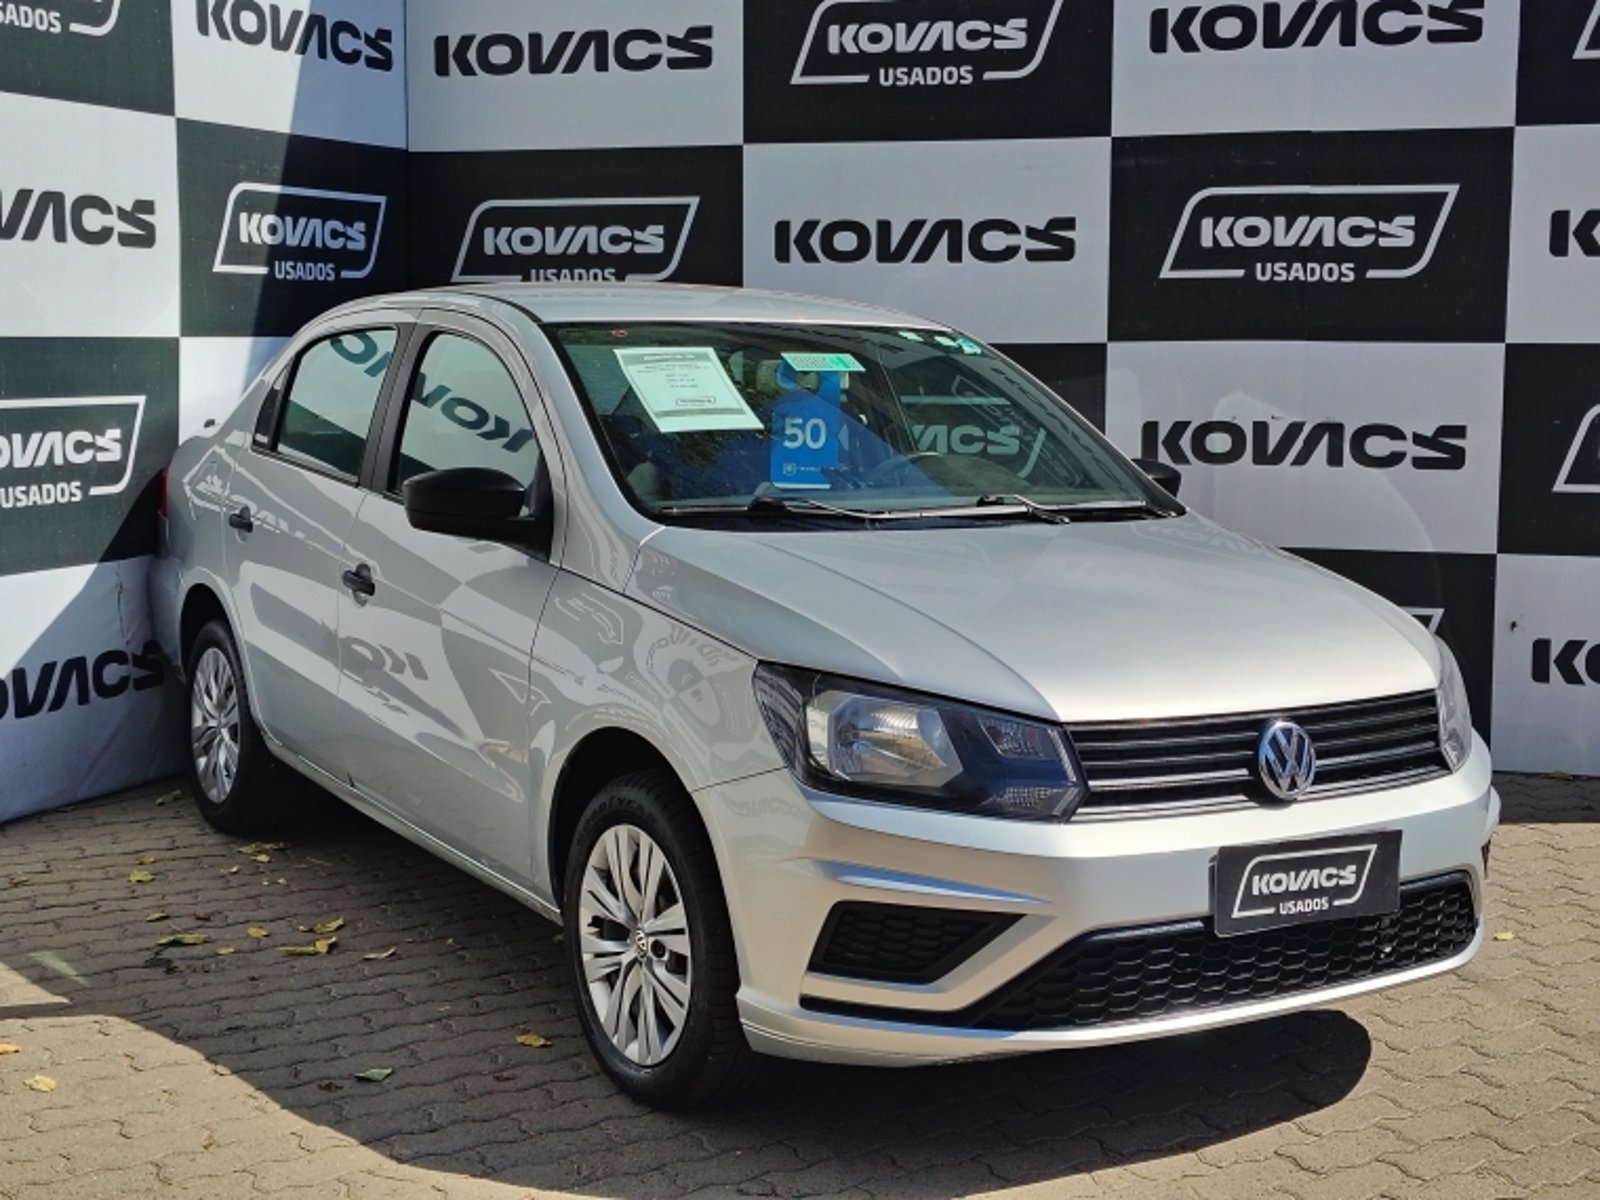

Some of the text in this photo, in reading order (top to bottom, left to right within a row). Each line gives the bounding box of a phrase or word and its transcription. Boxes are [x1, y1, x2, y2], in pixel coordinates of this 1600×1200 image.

[195, 0, 393, 71] KOVACS
[827, 18, 1028, 54] KOVACS
[1149, 0, 1485, 53] KOVACS
[434, 25, 713, 77] KOVACS
[879, 66, 974, 87] USADOS
[238, 212, 366, 250] KOVACS
[483, 225, 664, 256] KOVACS
[774, 216, 1077, 264] KOVACS
[1200, 215, 1416, 248] KOVACS
[274, 261, 335, 281] USADOS
[530, 268, 616, 282] USADOS
[1255, 262, 1355, 283] USADOS
[783, 417, 827, 449] 50
[1140, 420, 1468, 470] KOVACS
[0, 481, 82, 508] USADOS
[0, 640, 165, 719] VACS
[1252, 865, 1357, 896] KOVACS
[1279, 897, 1329, 915] USADOS
